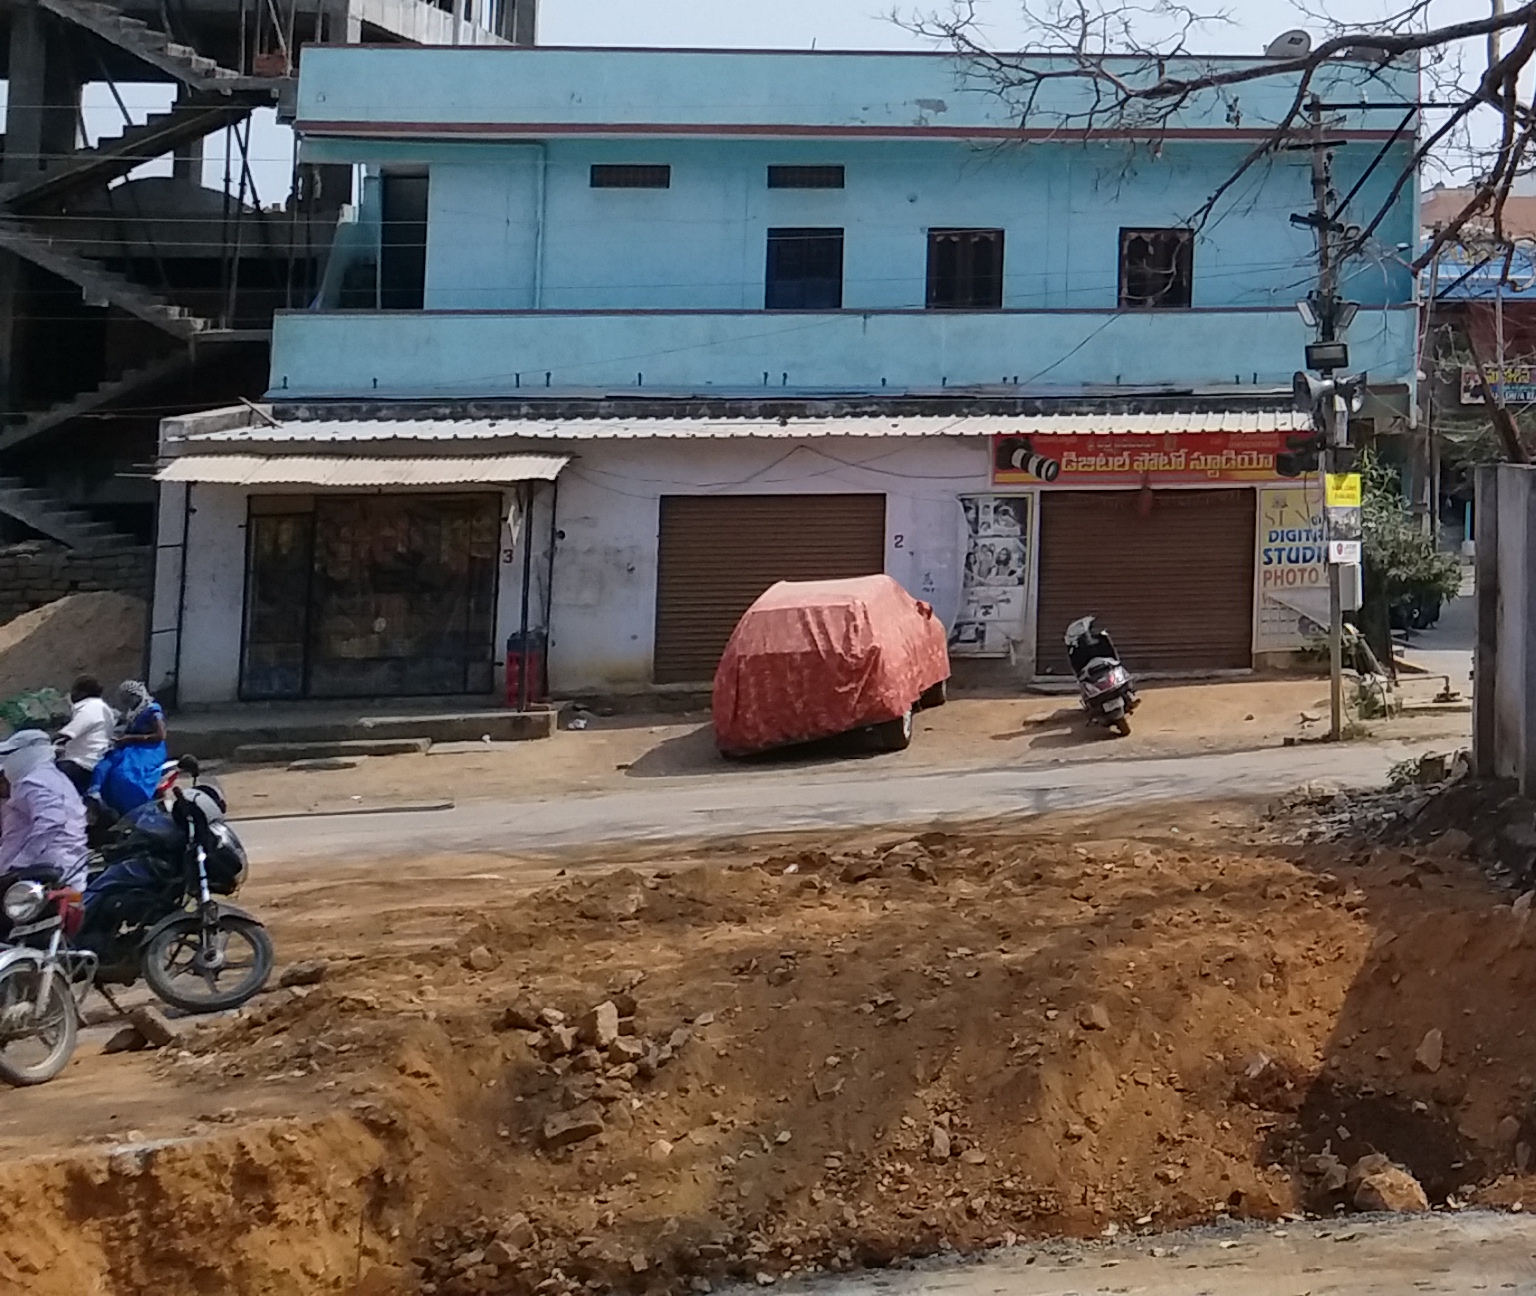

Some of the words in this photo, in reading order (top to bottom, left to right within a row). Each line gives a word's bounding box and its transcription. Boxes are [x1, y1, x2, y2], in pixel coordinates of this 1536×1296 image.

[894, 534, 904, 549] 2
[503, 549, 513, 563] 3
[1263, 567, 1319, 587] PHOTO
